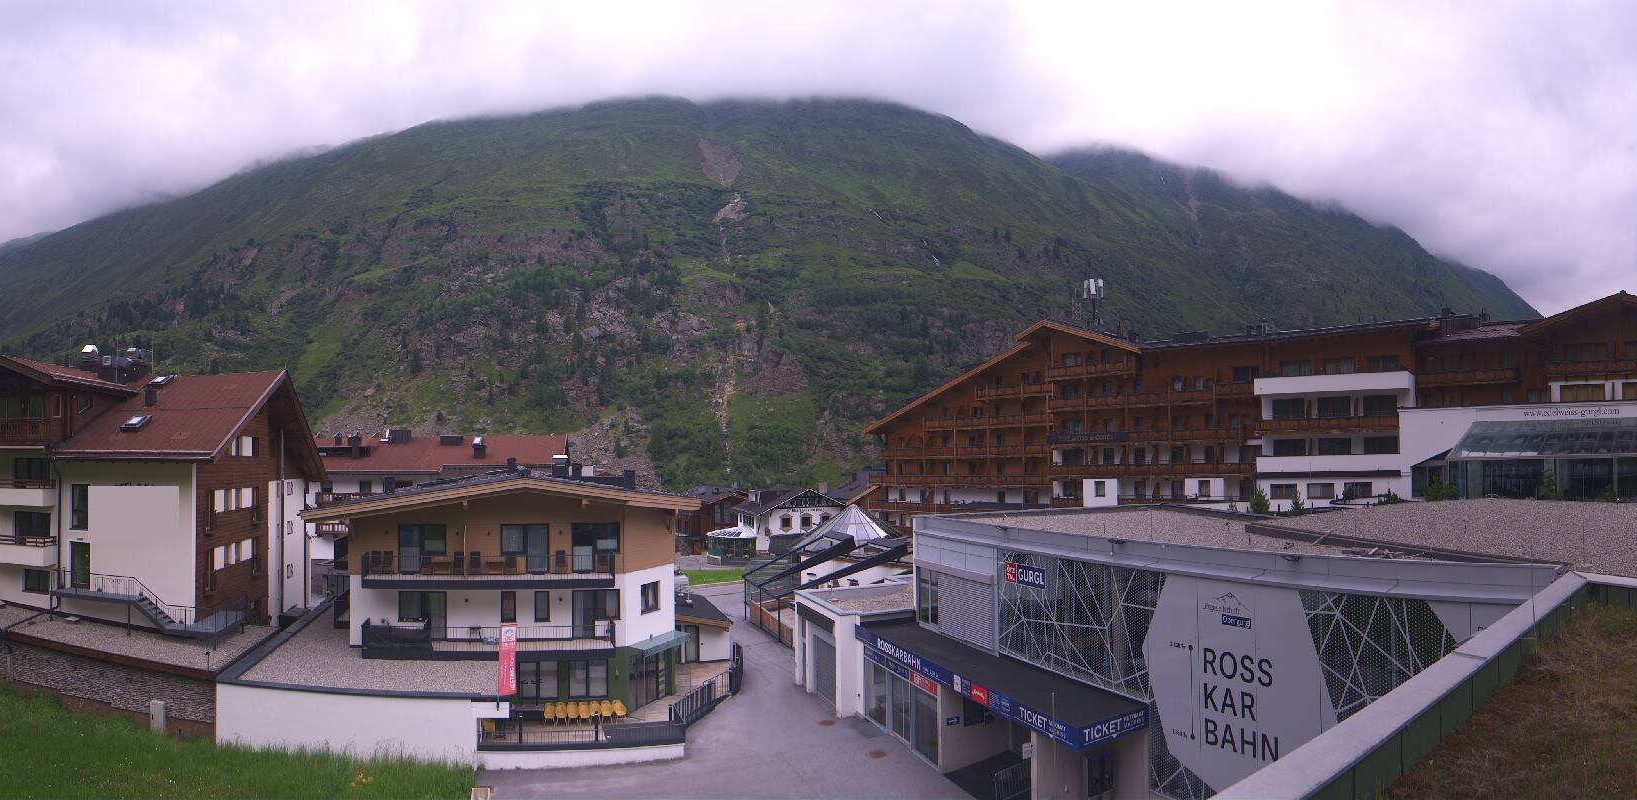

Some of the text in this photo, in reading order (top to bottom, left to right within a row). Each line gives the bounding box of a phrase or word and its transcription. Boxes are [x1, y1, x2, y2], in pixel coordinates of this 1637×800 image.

[1018, 568, 1045, 586] GURGL
[877, 637, 922, 671] ROSSKARBAHN
[1203, 647, 1273, 688] ROSS
[1019, 706, 1048, 730] TICKET
[1203, 682, 1257, 722] KAR
[1083, 717, 1123, 742] TICKET
[1204, 717, 1279, 762] BAHN
